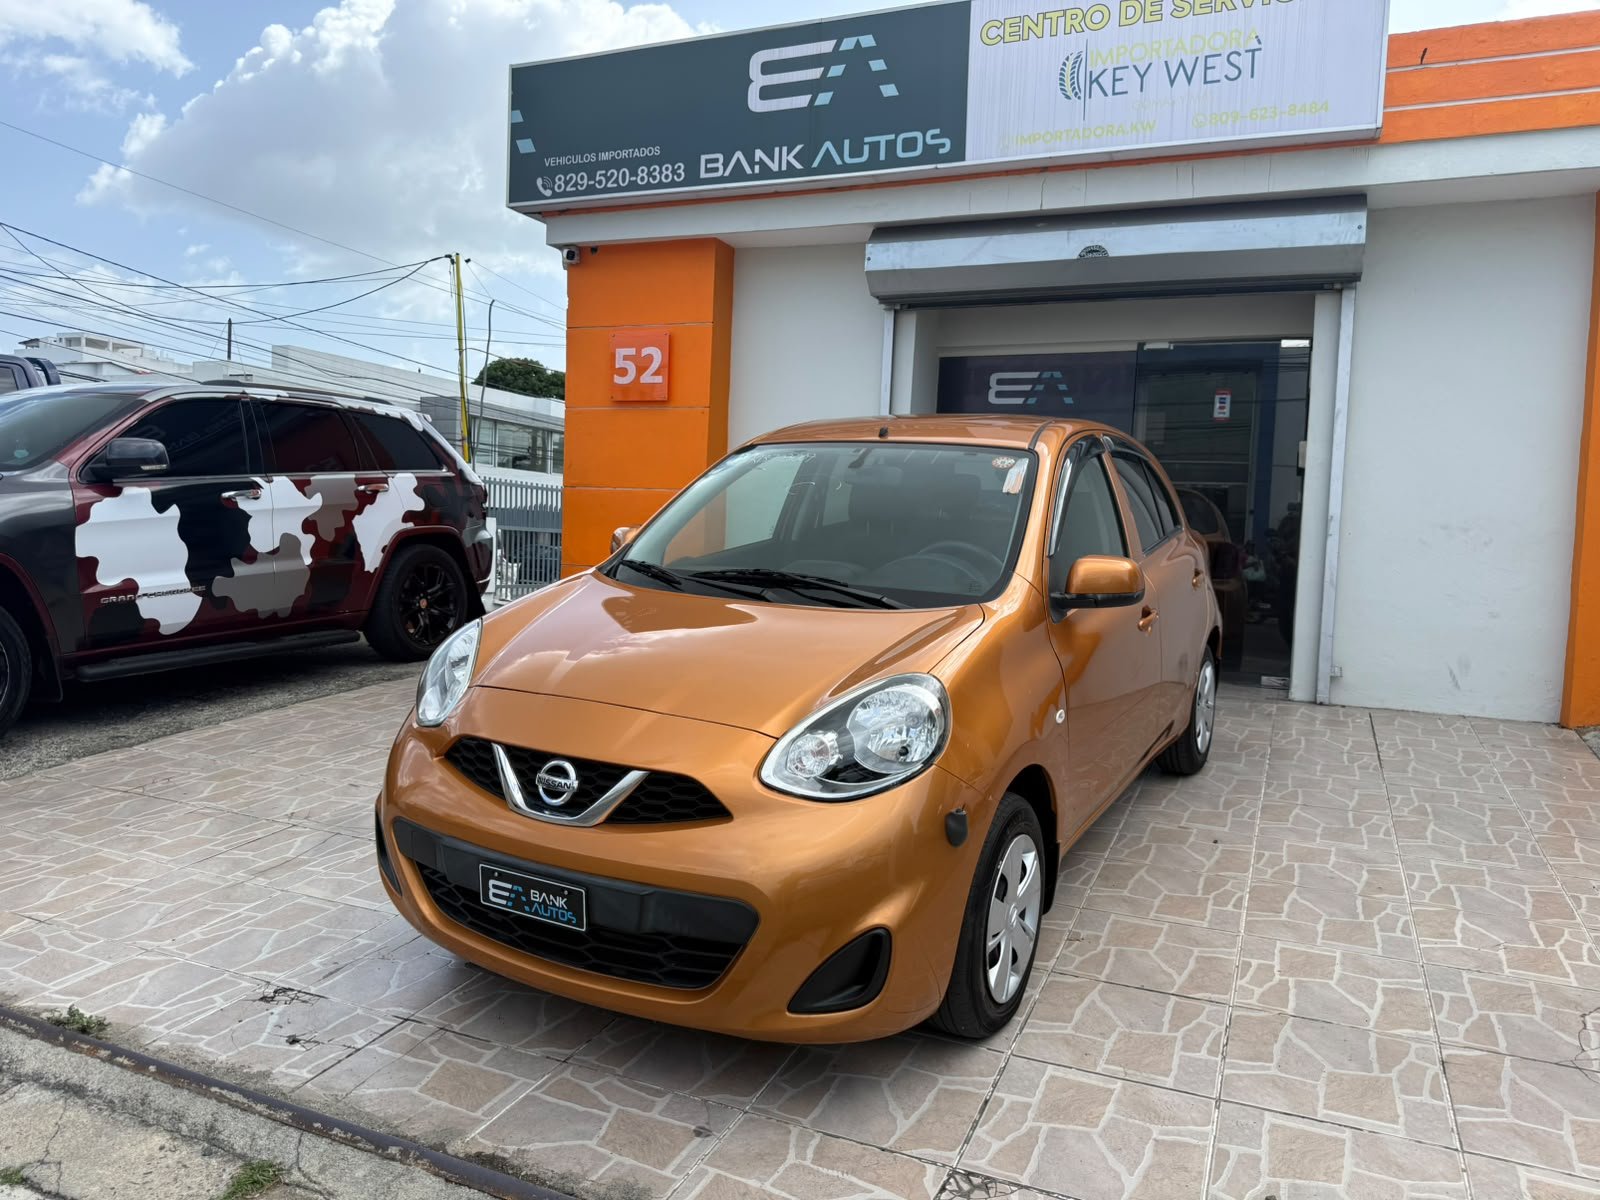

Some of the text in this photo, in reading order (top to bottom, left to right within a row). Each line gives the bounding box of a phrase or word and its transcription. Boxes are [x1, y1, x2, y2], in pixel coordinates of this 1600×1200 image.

[980, 4, 1111, 46] CENTRO
[1118, 0, 1164, 27] DE
[1088, 27, 1263, 69] IMPORTADORA
[1088, 47, 1263, 99] KEY WEST
[544, 146, 661, 167] VEHICULOS IMPORTADOS
[700, 128, 951, 179] BANK AUTOS
[554, 162, 686, 193] 829-520-8383
[613, 346, 663, 385] 52
[538, 775, 571, 789] NISSAN
[530, 889, 568, 910] BANK
[531, 903, 577, 924] AUTOS
